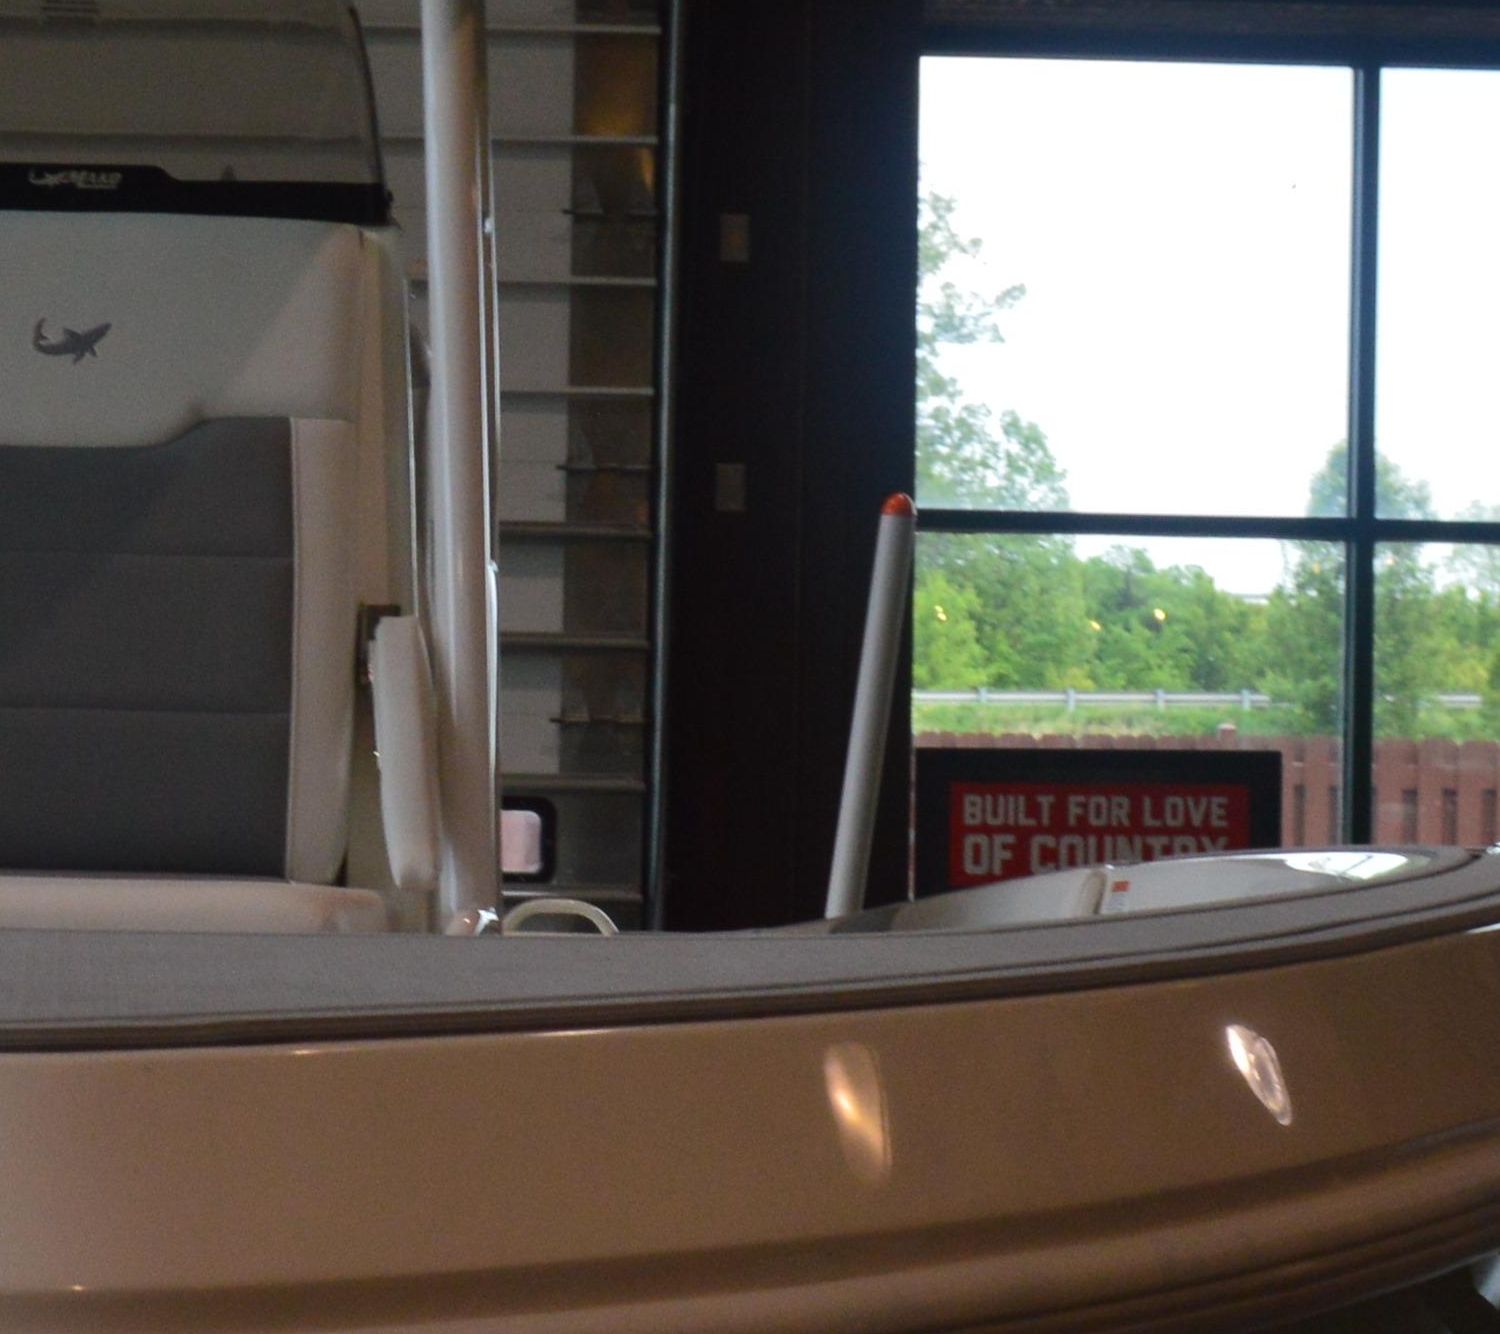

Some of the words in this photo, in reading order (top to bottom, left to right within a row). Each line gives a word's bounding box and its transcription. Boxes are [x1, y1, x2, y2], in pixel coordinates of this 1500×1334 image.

[962, 793, 1056, 827] BUILT
[1067, 794, 1132, 828] FOR
[1142, 795, 1230, 829] LOVE
[962, 833, 1018, 876] OF
